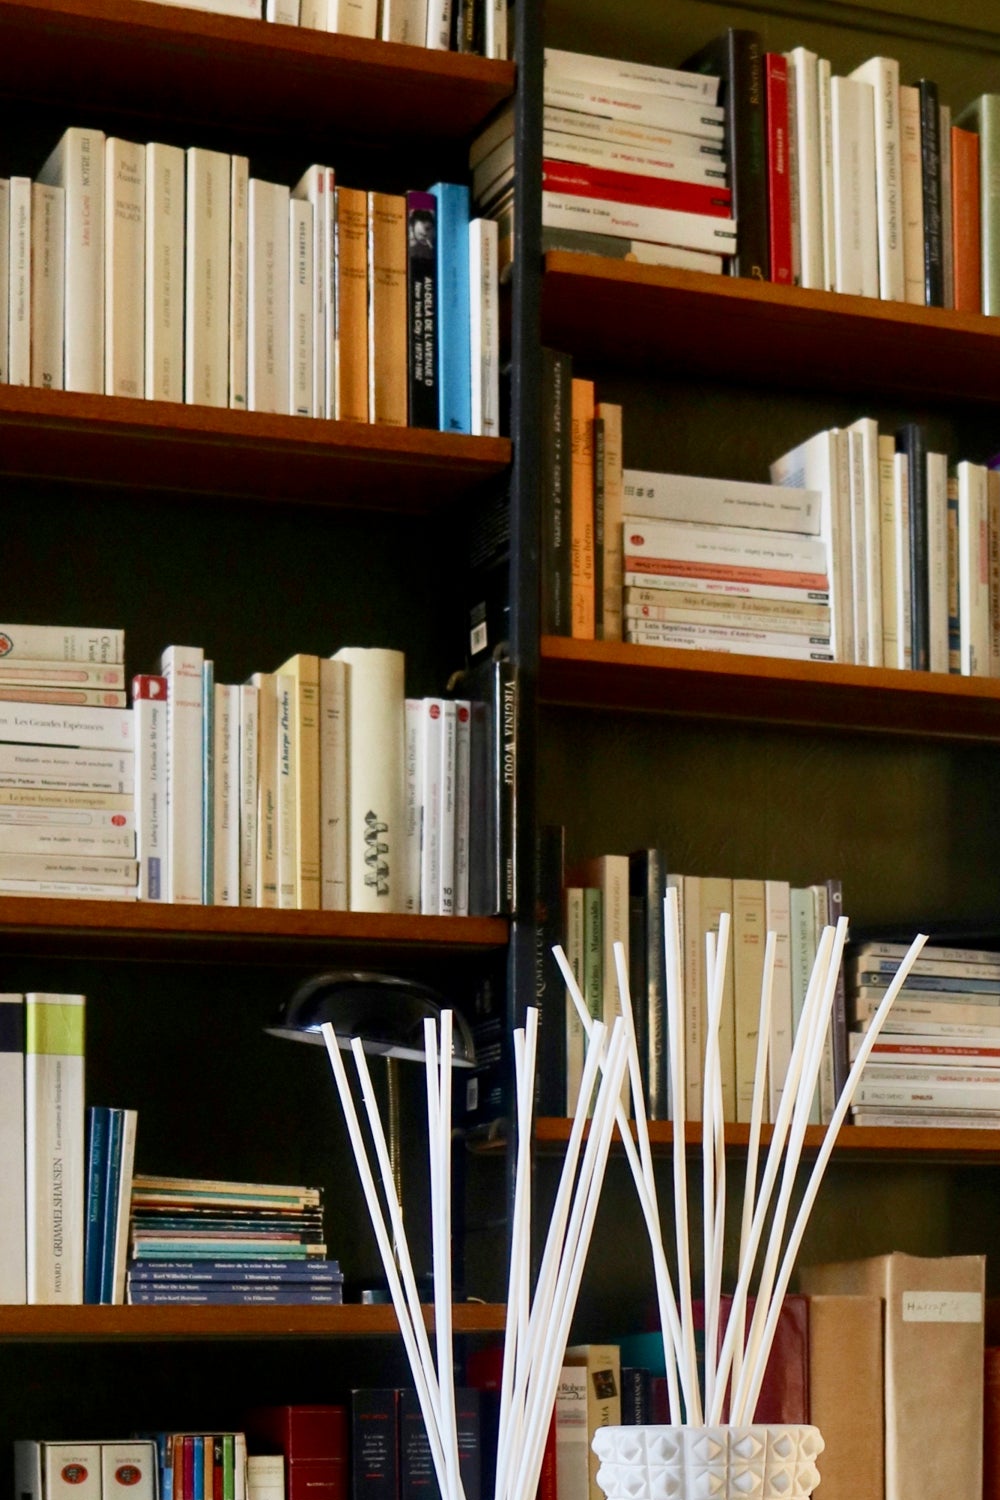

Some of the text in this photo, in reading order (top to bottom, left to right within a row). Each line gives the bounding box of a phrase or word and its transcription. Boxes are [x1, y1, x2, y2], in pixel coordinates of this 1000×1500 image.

[81, 137, 90, 187] NOTRE JEU
[414, 281, 422, 335] New York City
[424, 319, 433, 331] DE
[424, 333, 433, 377] L'AVENUE
[15, 718, 104, 732] Les Grandes Espérances
[149, 741, 159, 750] de
[282, 690, 292, 776] La harpe d'herbes
[504, 680, 515, 784] VIRGINIA WOOLF
[149, 751, 159, 771] Destin
[149, 772, 159, 781] Le
[244, 739, 256, 805] Petit déjeuner chez
[407, 728, 417, 777] Mrs Dalloway
[221, 771, 231, 830] Truman Capote
[265, 789, 275, 861] Truman Capote
[407, 783, 417, 837] Virginia Woolf
[149, 823, 159, 848] Ludwig
[244, 812, 254, 867] Truman Capote
[443, 887, 453, 895] 10
[443, 899, 453, 907] 18
[589, 900, 600, 953] Marcovaldo
[589, 964, 600, 998] Calvino
[54, 1111, 63, 1151] Les aventures
[53, 1158, 63, 1257] GRIMMELSHAUSEN
[91, 1173, 99, 1222] Manon Lescaut
[54, 1263, 62, 1293] FAYARD
